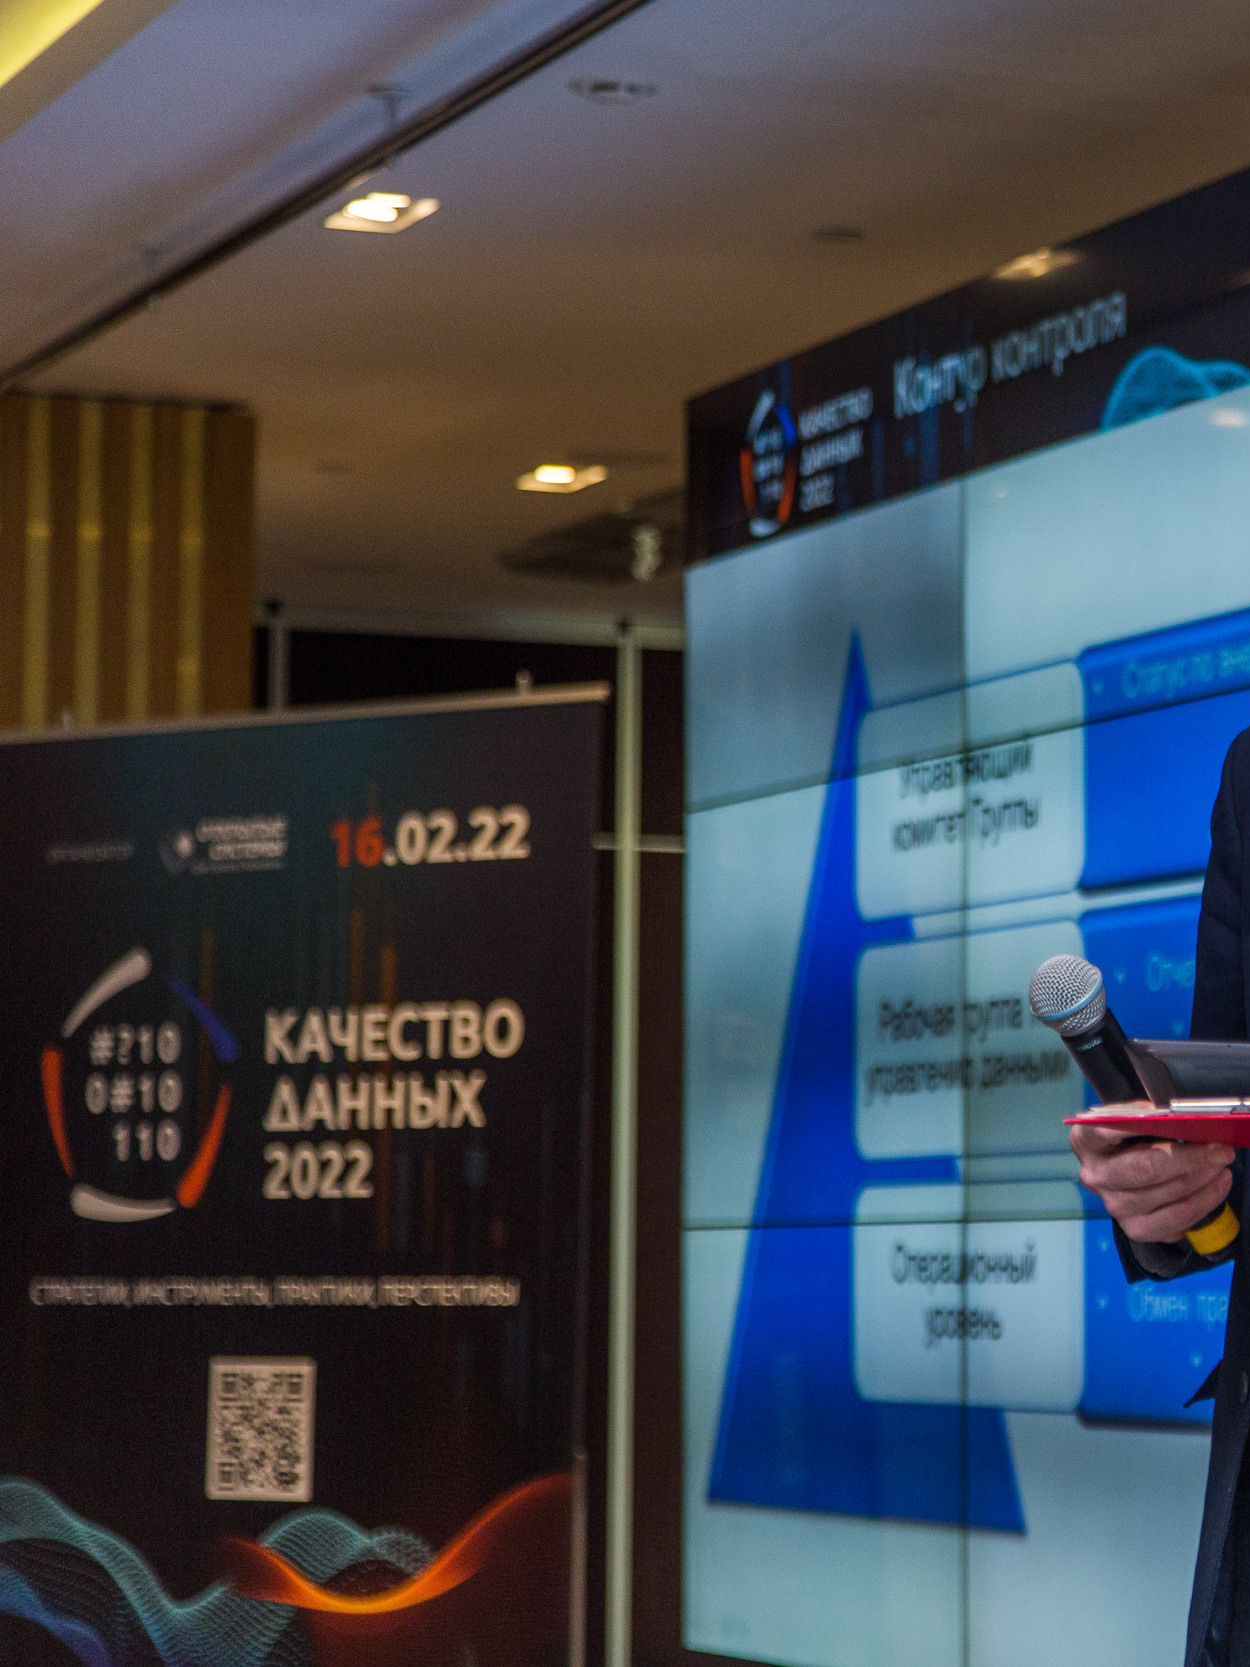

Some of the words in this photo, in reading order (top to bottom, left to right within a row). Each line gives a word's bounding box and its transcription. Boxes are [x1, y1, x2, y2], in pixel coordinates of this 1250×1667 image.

[992, 291, 1127, 377] контроля
[331, 804, 531, 868] 16.02.22
[263, 998, 526, 1065] КАЧЕСТВО
[263, 1072, 487, 1132] ДАННЫХ
[263, 1140, 374, 1199] 2022
